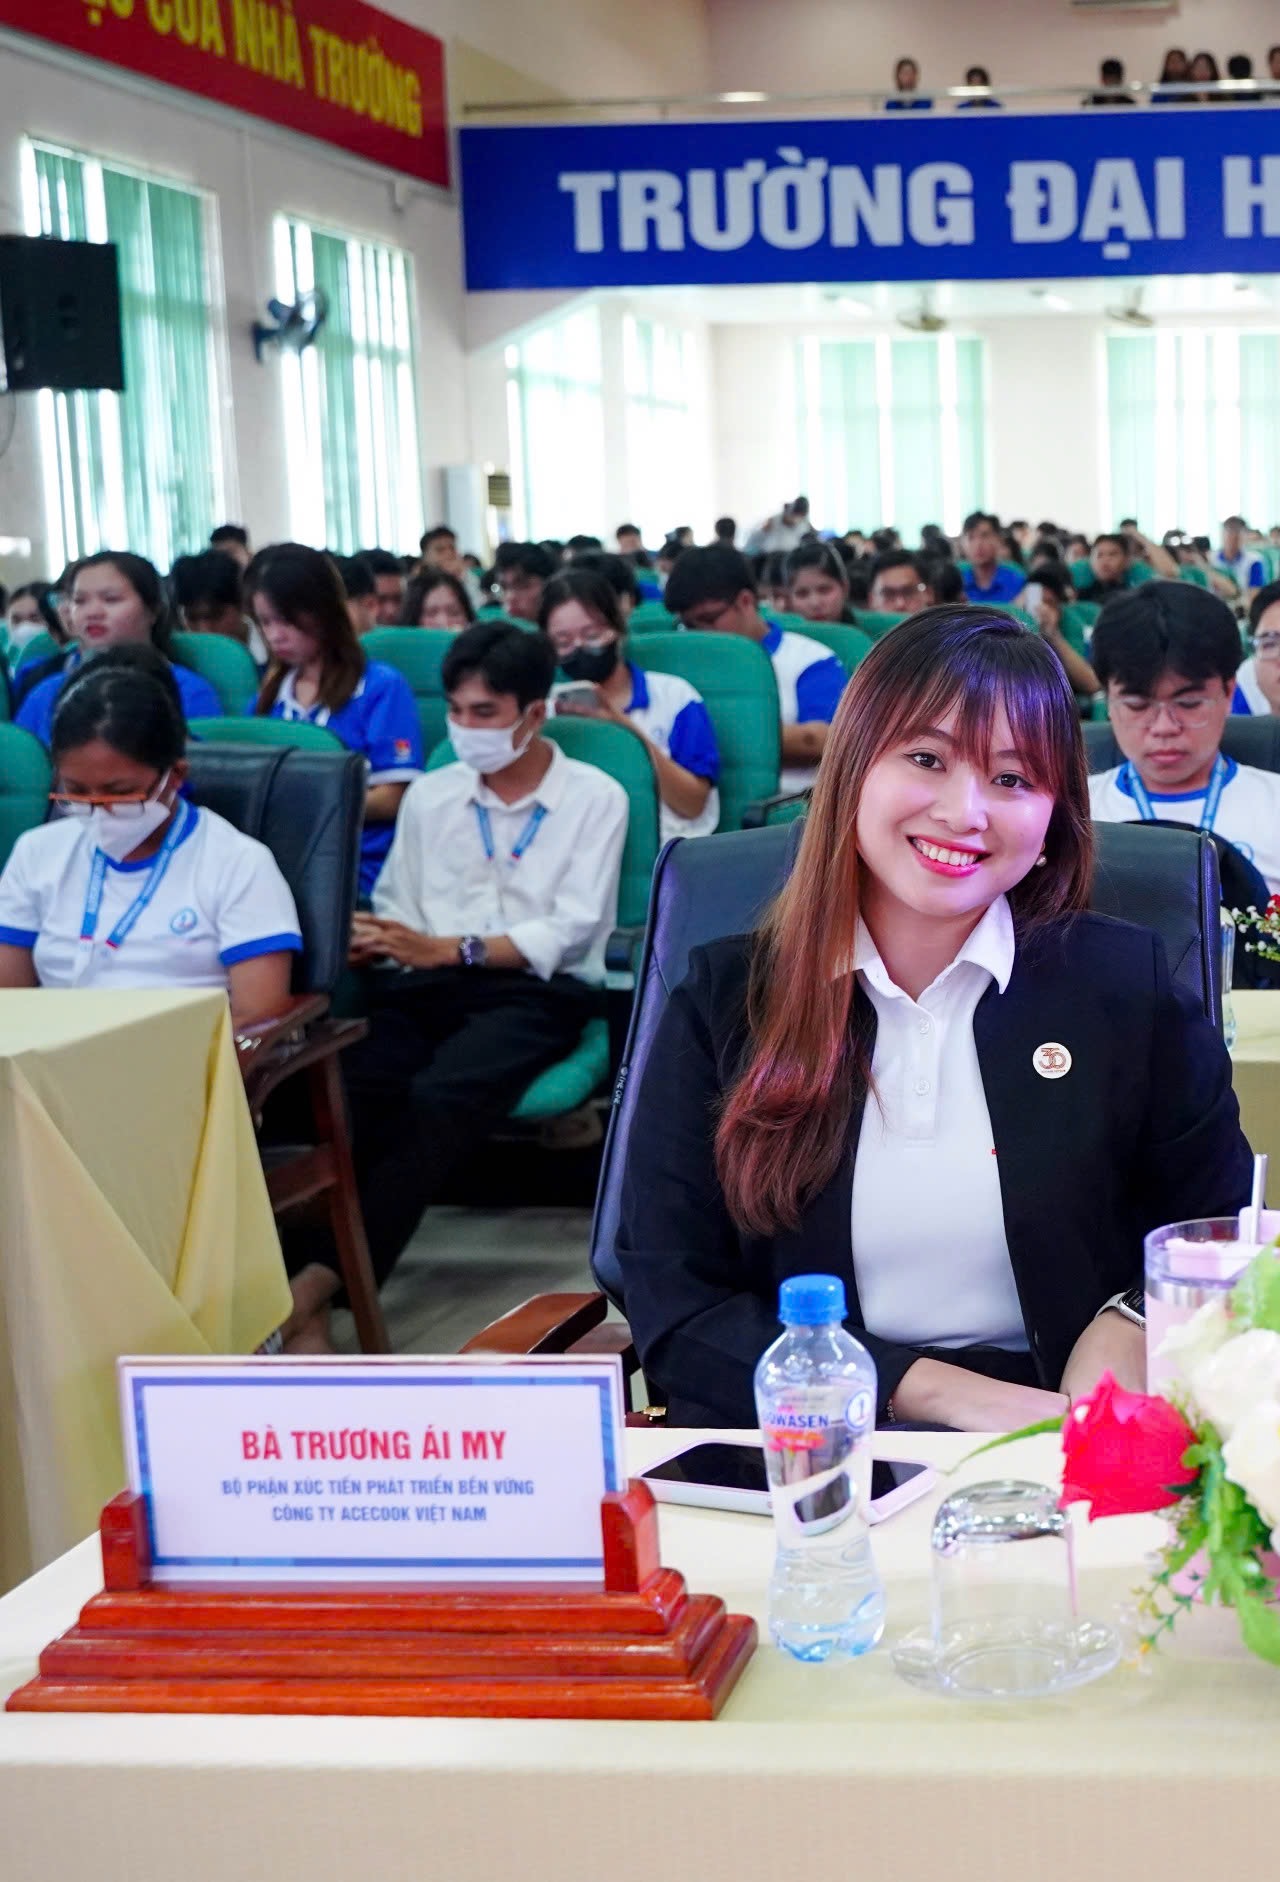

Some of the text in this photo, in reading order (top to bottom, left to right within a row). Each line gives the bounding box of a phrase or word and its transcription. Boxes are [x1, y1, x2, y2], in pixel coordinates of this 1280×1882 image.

[308, 25, 423, 138] TRƯỜNG
[558, 146, 975, 252] TRƯỜNG
[1006, 157, 1185, 259] ĐẠI
[241, 1424, 507, 1460] BÀ TRƯƠNG ÁI MY
[221, 1477, 243, 1499] BỘ
[247, 1477, 289, 1499] PHẬN
[272, 1503, 487, 1525] CÔNG TY ACECOOK VIỆT NAM
